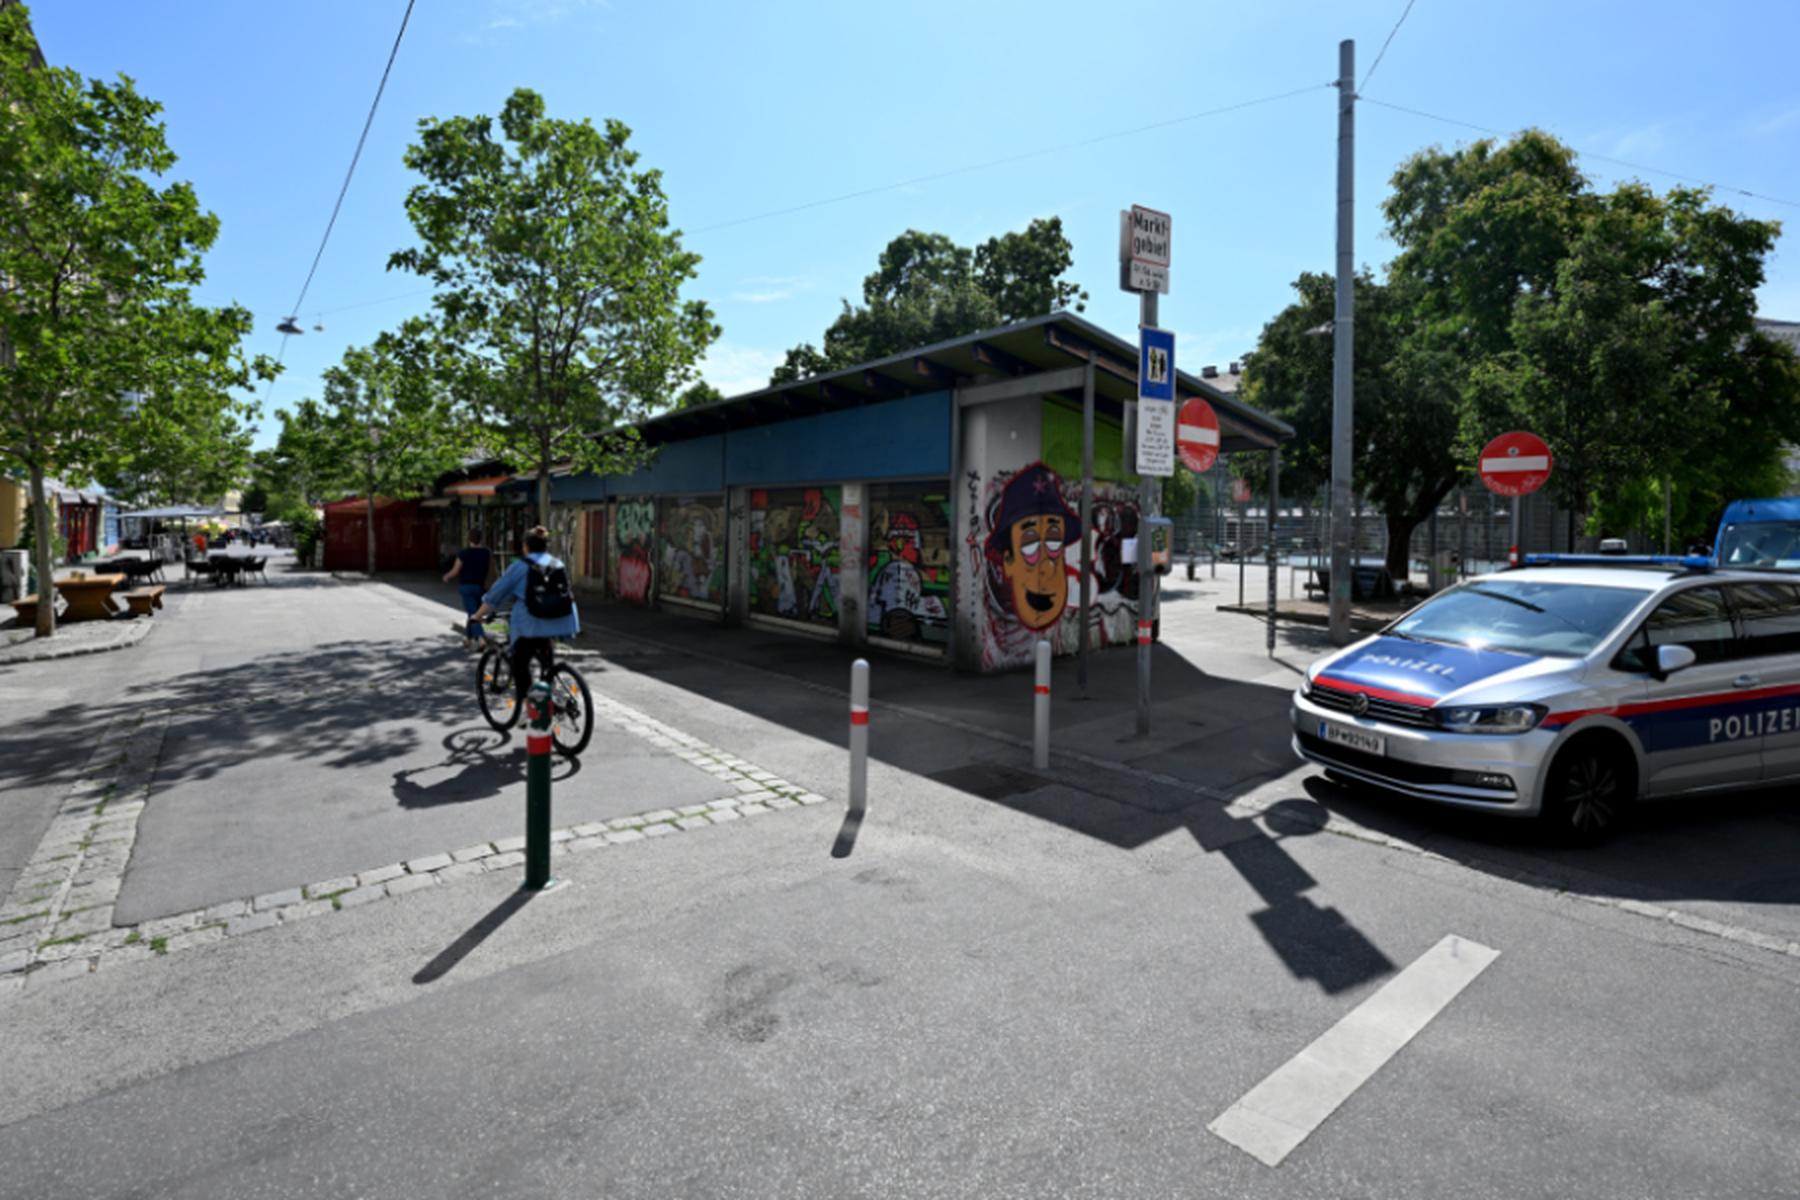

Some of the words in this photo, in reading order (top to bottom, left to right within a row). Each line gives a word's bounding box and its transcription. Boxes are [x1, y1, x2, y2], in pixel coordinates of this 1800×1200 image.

[1135, 236, 1168, 257] gebiet
[1361, 653, 1455, 676] POLIZEI
[1710, 707, 1800, 742] POLIZEI
